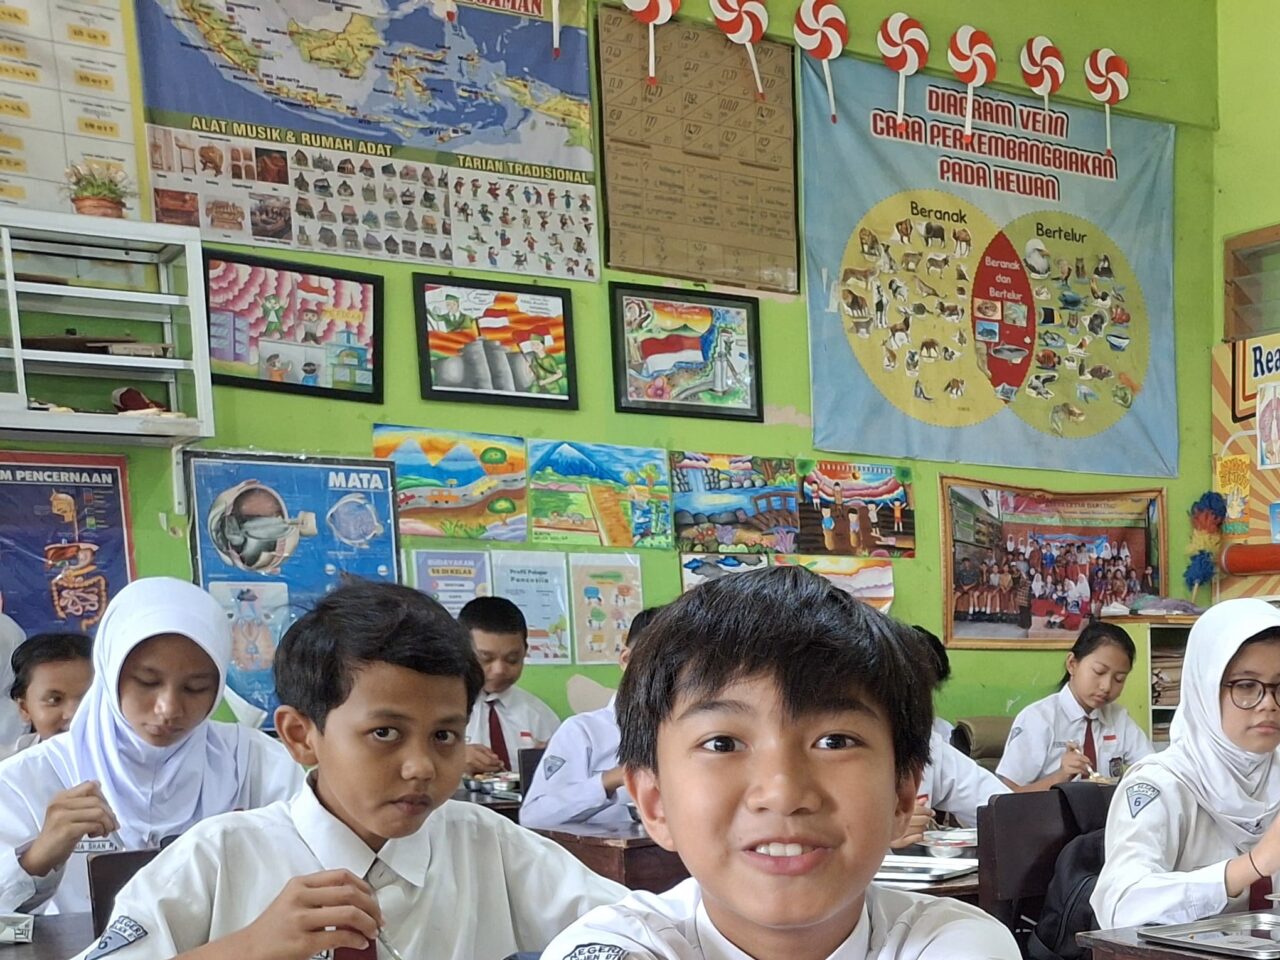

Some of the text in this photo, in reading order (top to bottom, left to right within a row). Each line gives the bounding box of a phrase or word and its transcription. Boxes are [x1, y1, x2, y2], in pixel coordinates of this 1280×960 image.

[926, 87, 1069, 138] DIAGRAM VENN
[191, 116, 228, 134] ALAT
[232, 122, 281, 142] MUSIK
[284, 131, 297, 143] &
[301, 132, 354, 153] RUMAH
[357, 142, 393, 157] ADAT
[871, 112, 1117, 179] CARA PERKEMBANGBIAKAN
[457, 154, 504, 173] TARIAN
[507, 161, 589, 184] TRADISIONAL
[939, 157, 1059, 201] PADA HEWAN
[910, 201, 968, 224] Beranak
[1036, 222, 1088, 244] Bertelur
[985, 256, 1021, 271] Beranak
[996, 273, 1012, 285] dan
[989, 286, 1023, 301] Bertelur
[16, 470, 113, 484] PENCERNAAN
[328, 471, 384, 490] MATA
[1133, 797, 1141, 807] 6
[97, 935, 113, 950] 6
